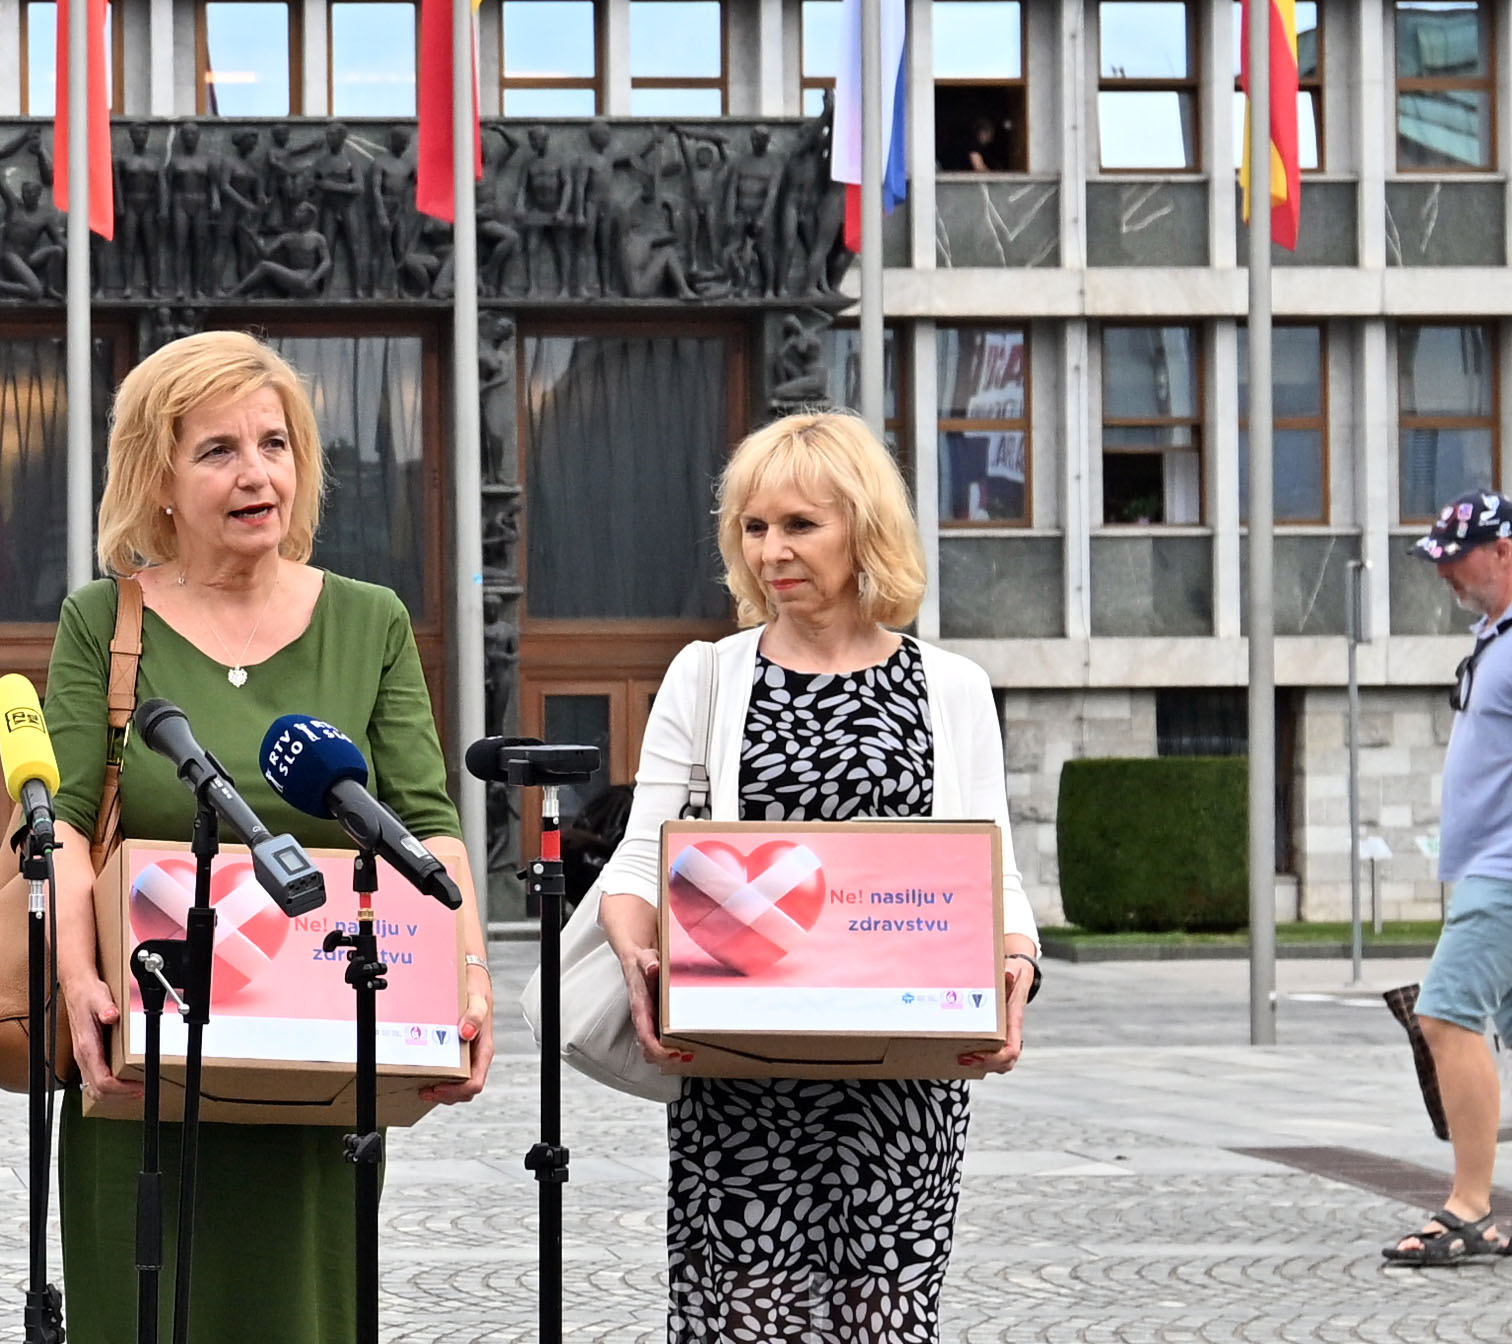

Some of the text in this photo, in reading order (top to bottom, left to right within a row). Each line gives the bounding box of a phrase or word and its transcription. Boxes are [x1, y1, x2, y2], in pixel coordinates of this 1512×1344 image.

[268, 729, 291, 766] RTV
[279, 740, 303, 776] SLO
[830, 888, 954, 907] Ne! nasilju v
[295, 917, 418, 937] Ne! nalju v
[848, 916, 948, 931] zdravstvu
